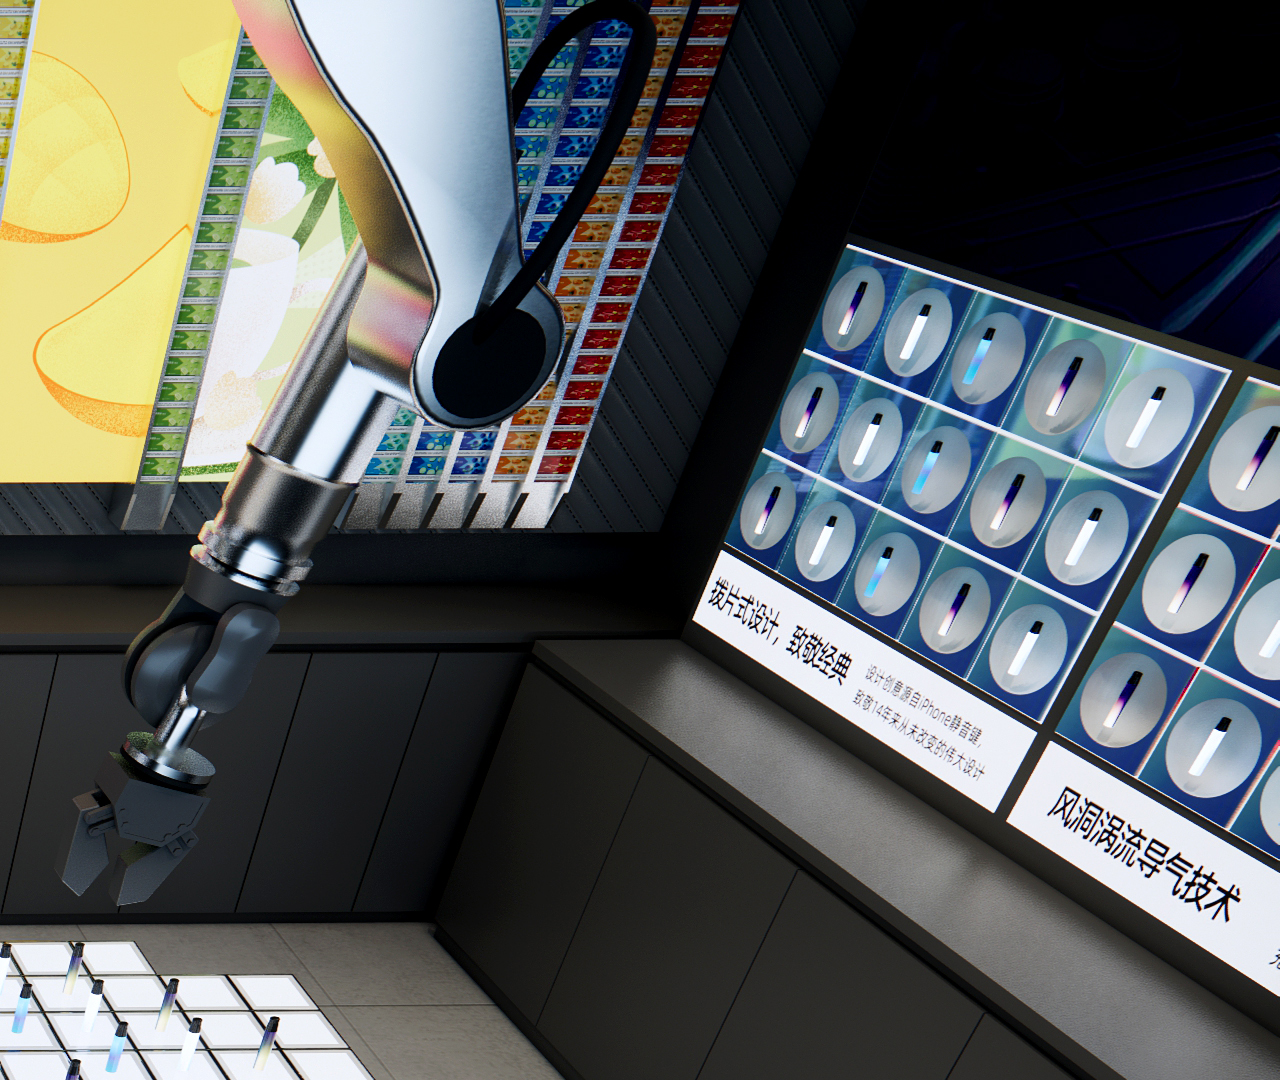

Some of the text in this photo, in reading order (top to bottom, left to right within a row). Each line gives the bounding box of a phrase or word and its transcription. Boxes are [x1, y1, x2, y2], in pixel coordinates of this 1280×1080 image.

[852, 688, 985, 782] 致敬14年来从未改变的伟大设计
[1047, 786, 1242, 923] 风洞涡流导气技术
